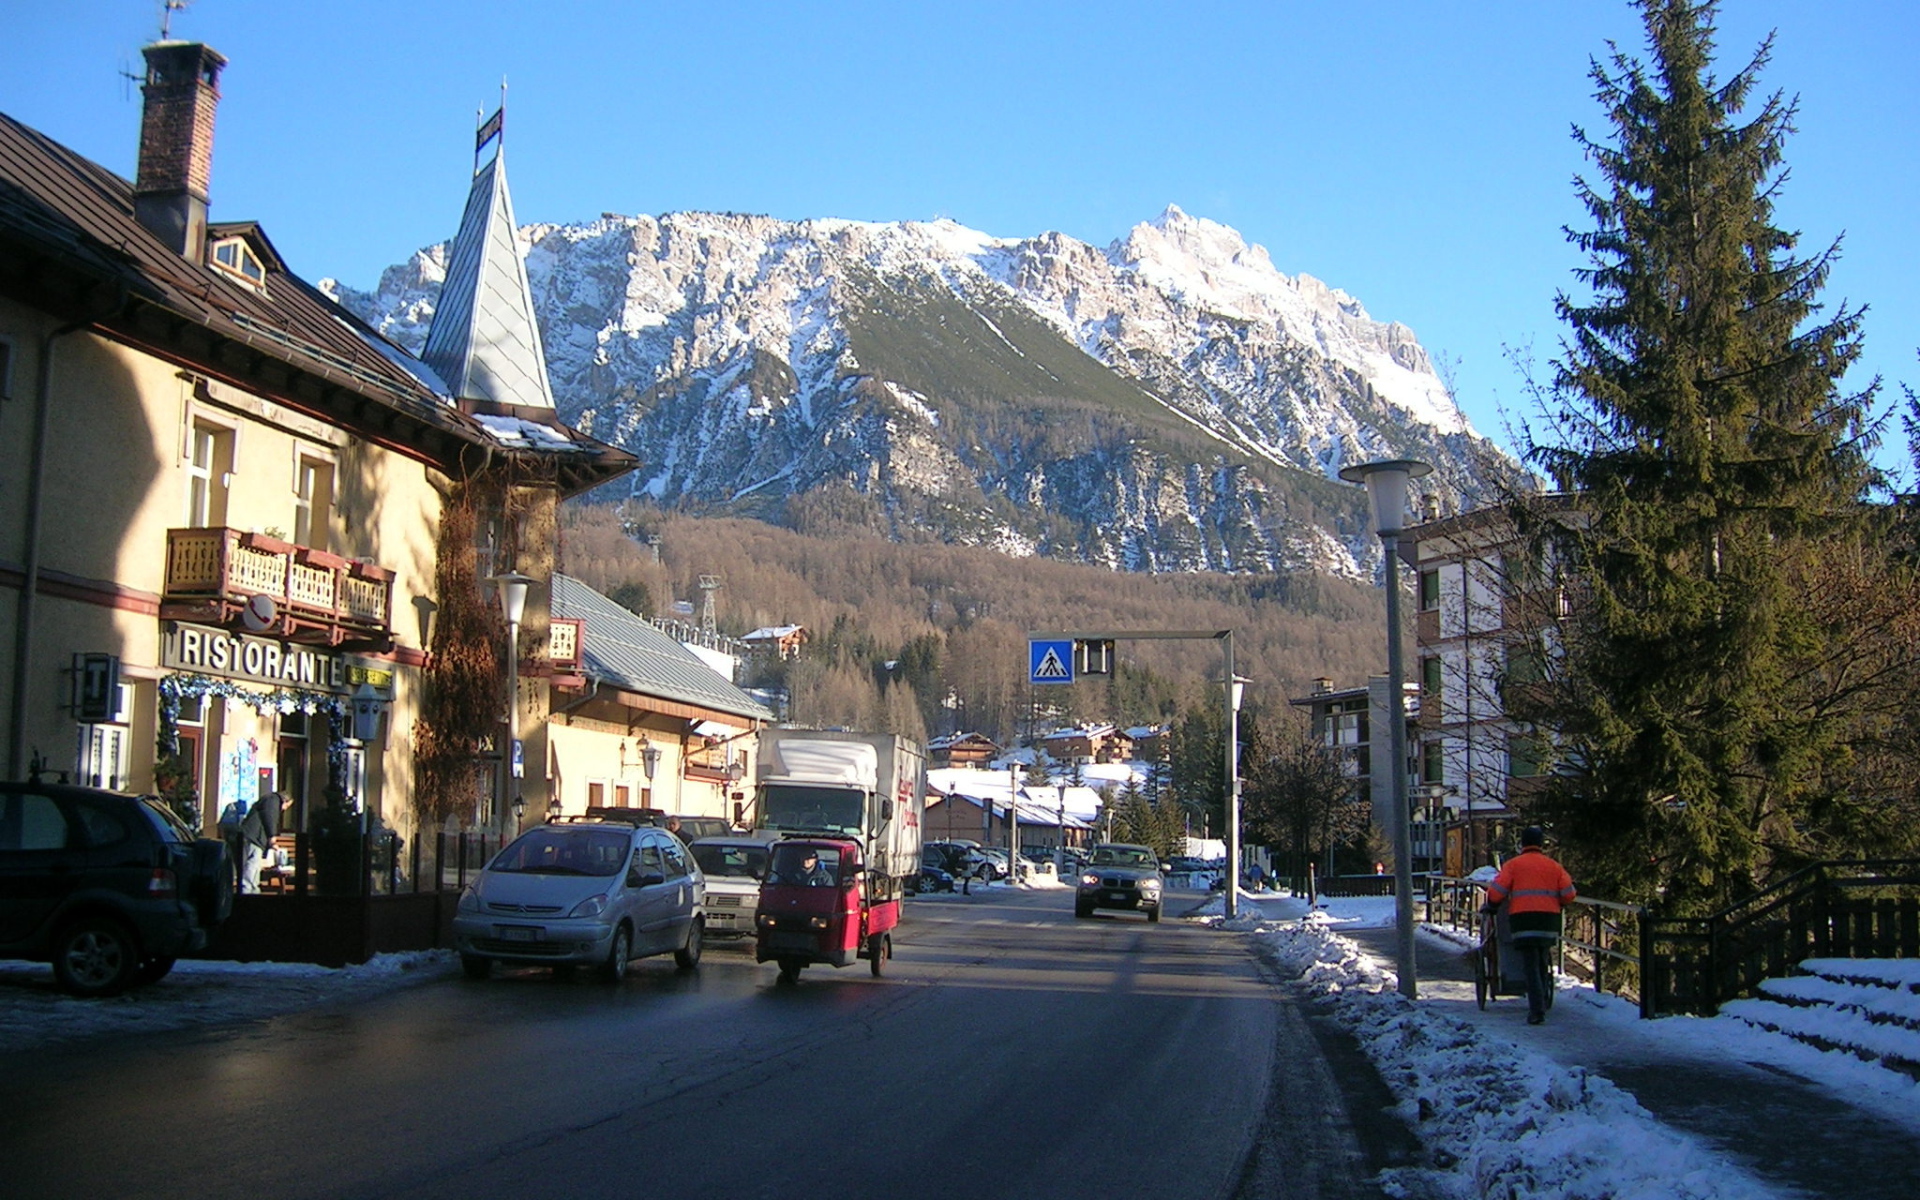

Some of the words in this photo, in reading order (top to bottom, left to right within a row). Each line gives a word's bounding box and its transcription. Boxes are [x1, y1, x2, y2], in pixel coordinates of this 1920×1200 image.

[181, 629, 343, 688] RISTORANTE
[87, 661, 108, 699] T
[514, 741, 522, 762] P
